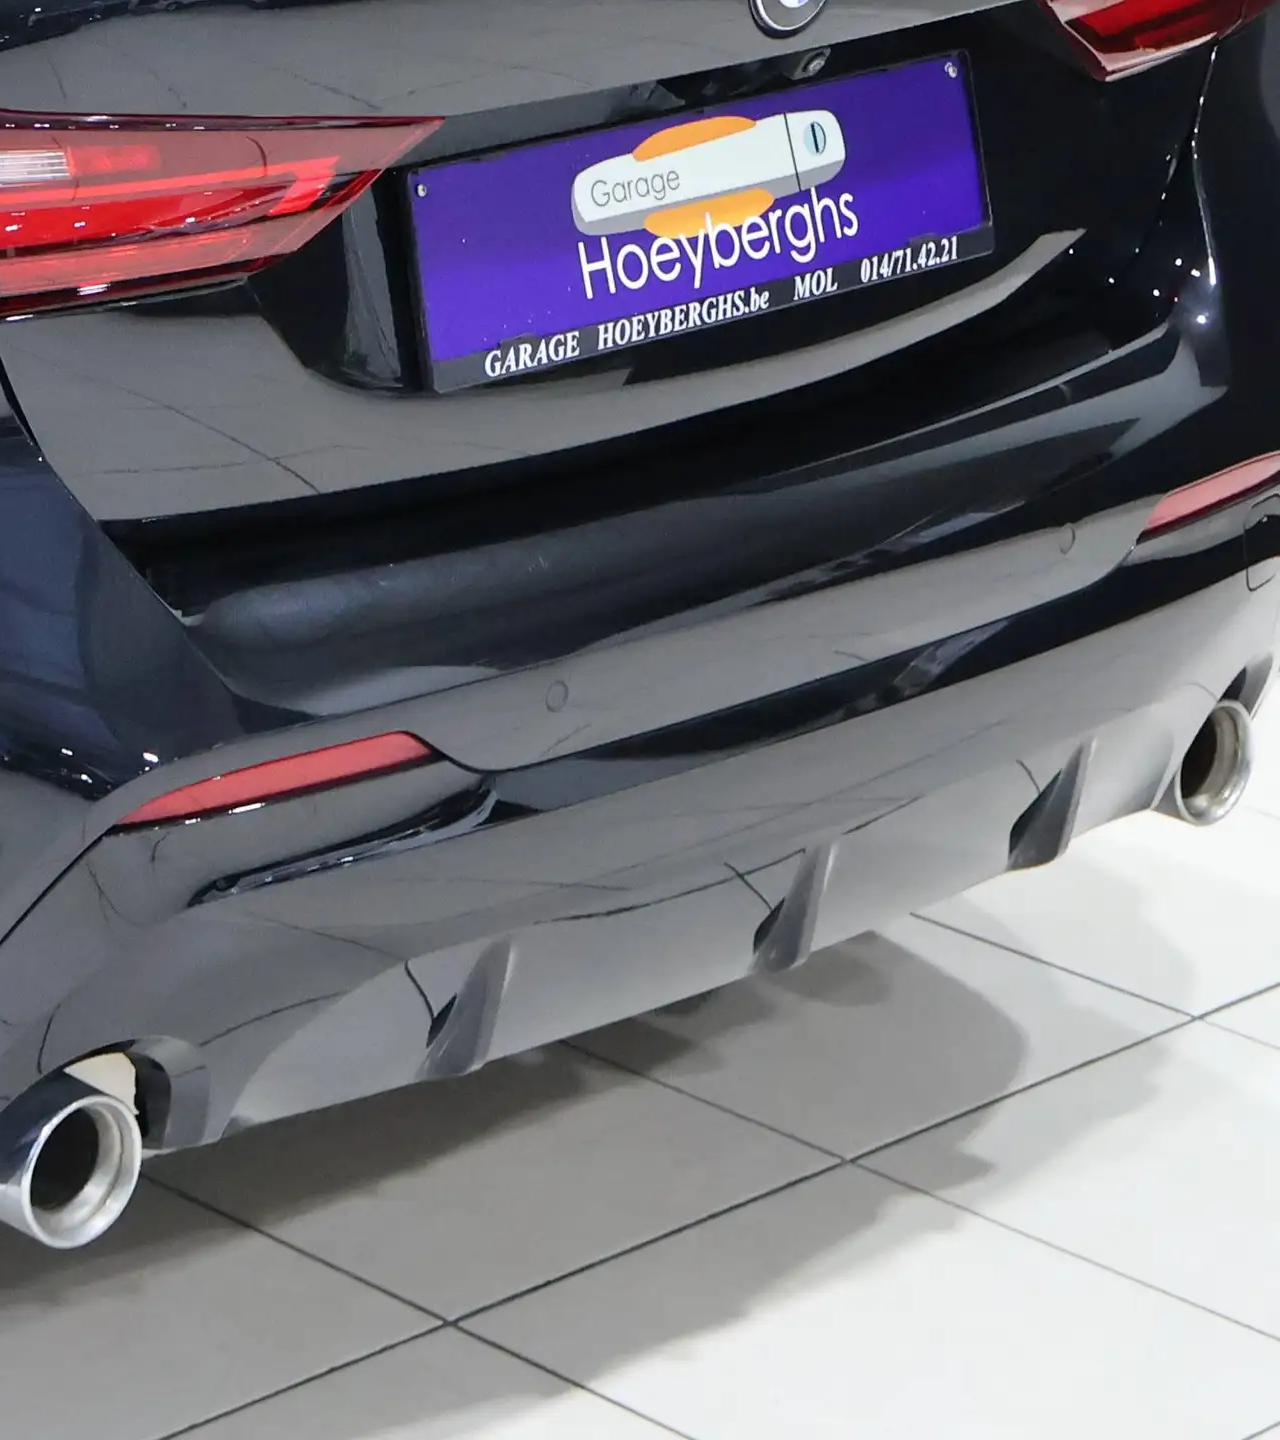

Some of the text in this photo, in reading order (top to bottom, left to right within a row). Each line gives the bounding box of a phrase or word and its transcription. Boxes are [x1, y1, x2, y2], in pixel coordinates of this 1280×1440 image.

[578, 186, 859, 300] Hoeyberghs
[591, 170, 681, 207] Garage
[484, 235, 959, 378] GARAGE HOEYBERGHS.be MOL 014/71.42.21
